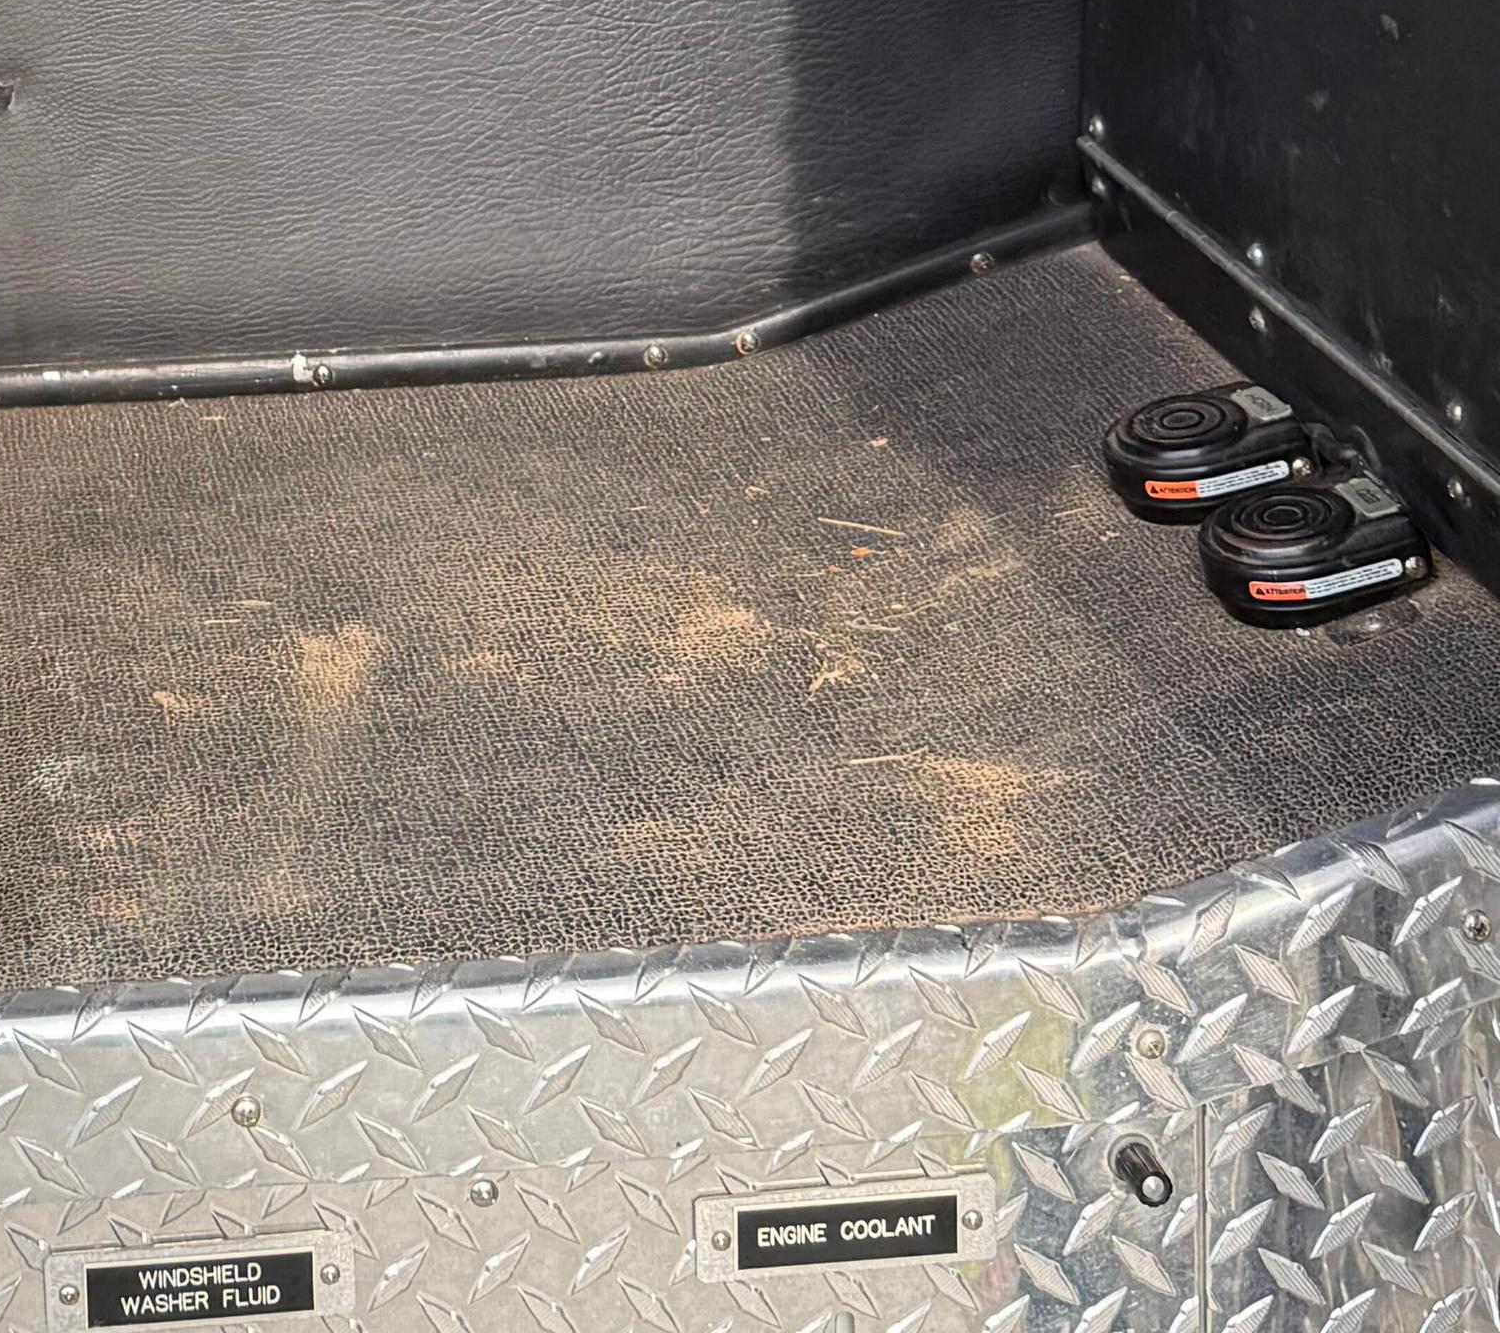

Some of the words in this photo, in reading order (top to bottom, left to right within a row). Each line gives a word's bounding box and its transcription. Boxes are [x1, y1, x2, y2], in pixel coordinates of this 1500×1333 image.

[757, 1223, 827, 1247] ENGINE
[840, 1214, 936, 1240] COOLANT
[138, 1262, 262, 1290] WINDSHIELD
[121, 1290, 209, 1317] WASHER
[222, 1284, 281, 1308] FLUID
